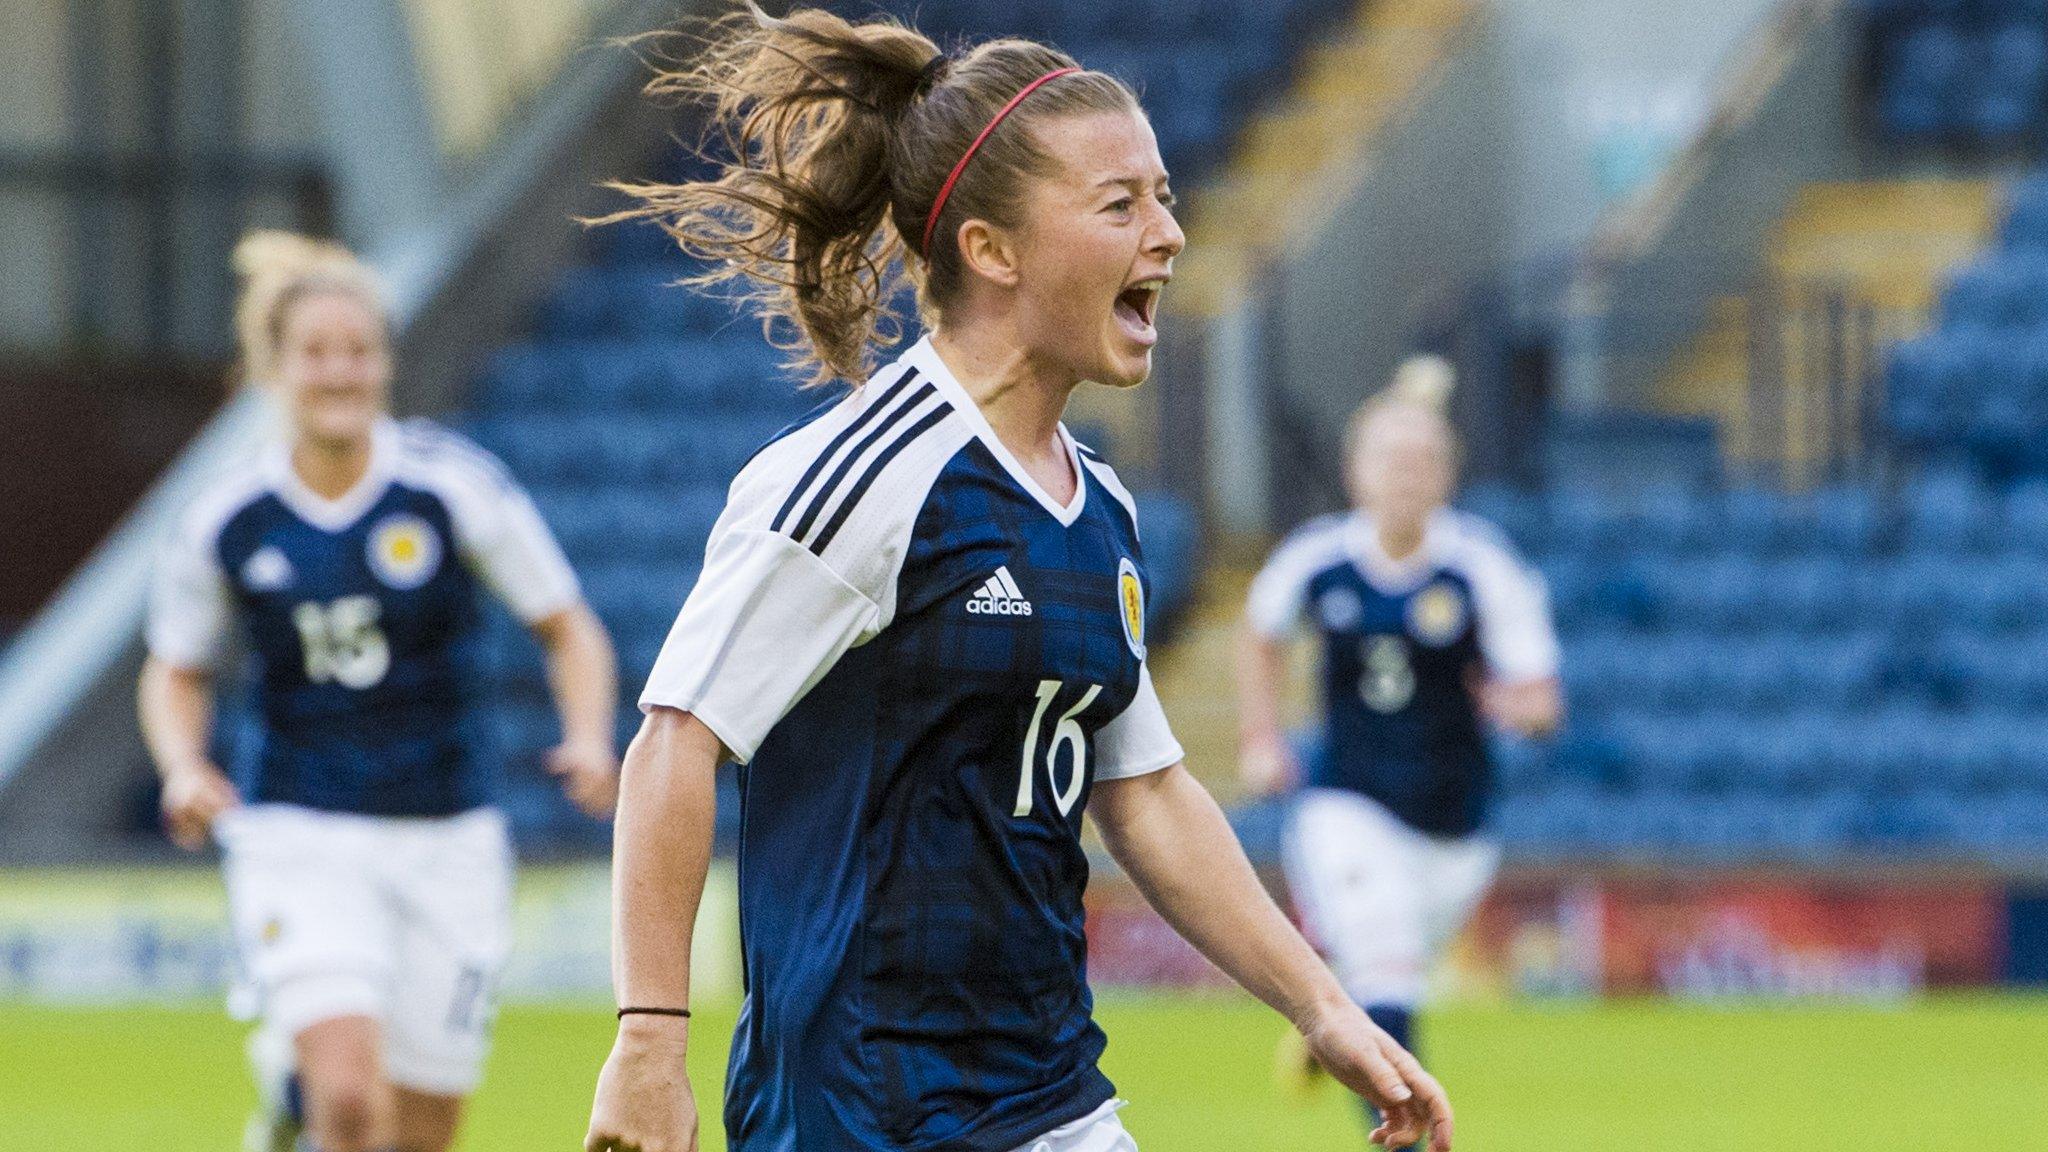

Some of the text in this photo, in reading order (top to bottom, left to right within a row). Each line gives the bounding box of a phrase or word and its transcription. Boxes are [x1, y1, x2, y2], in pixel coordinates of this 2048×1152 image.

[293, 597, 391, 688] 15
[965, 597, 1033, 616] adidas
[1012, 679, 1103, 818] 16
